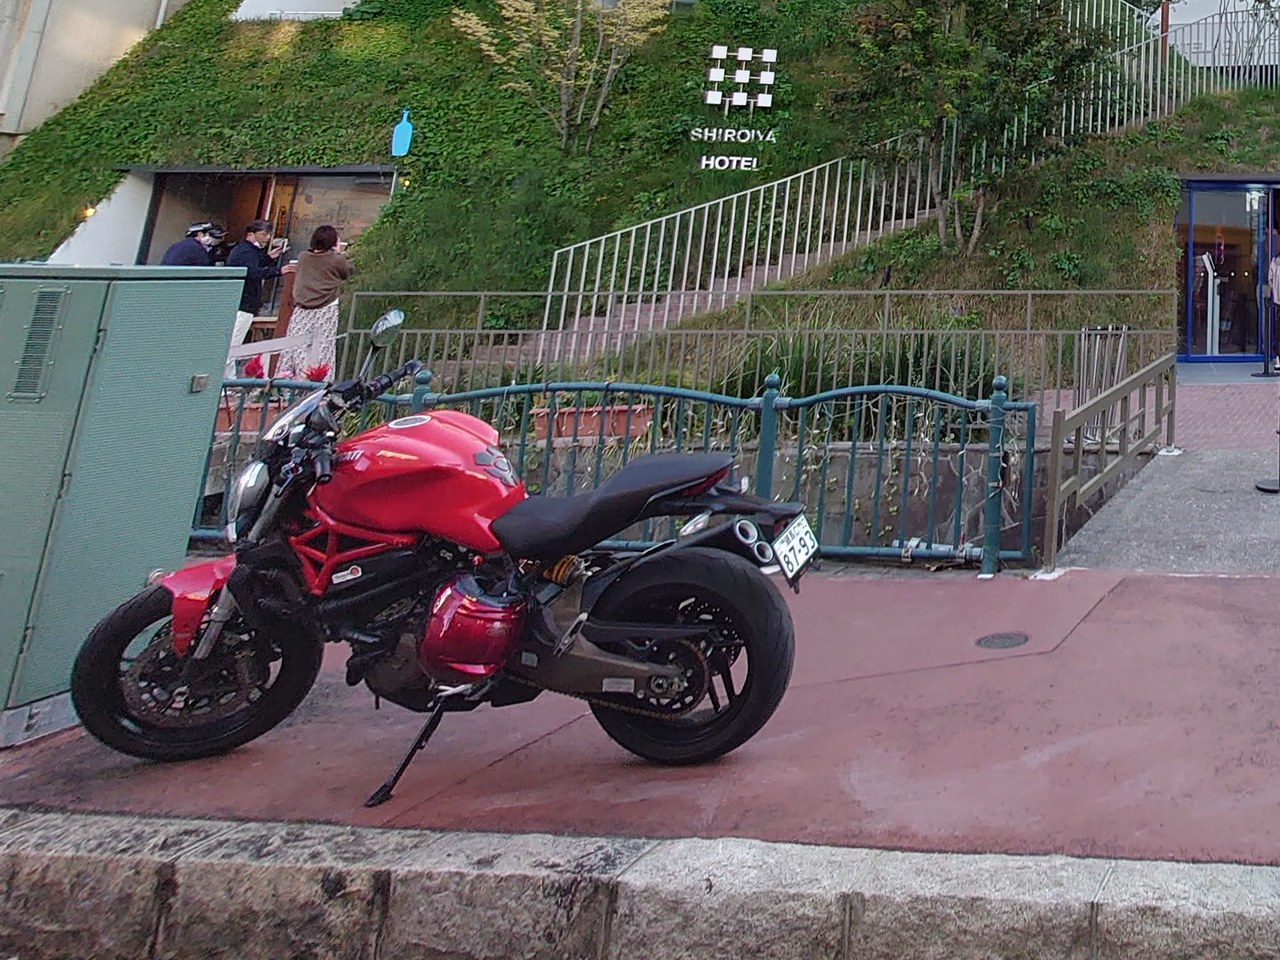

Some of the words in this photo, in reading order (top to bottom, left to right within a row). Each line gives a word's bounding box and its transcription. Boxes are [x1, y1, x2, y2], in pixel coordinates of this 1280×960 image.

[691, 128, 776, 143] SHIROIYA
[701, 156, 760, 171] HOTEL
[783, 530, 815, 573] 87-93
